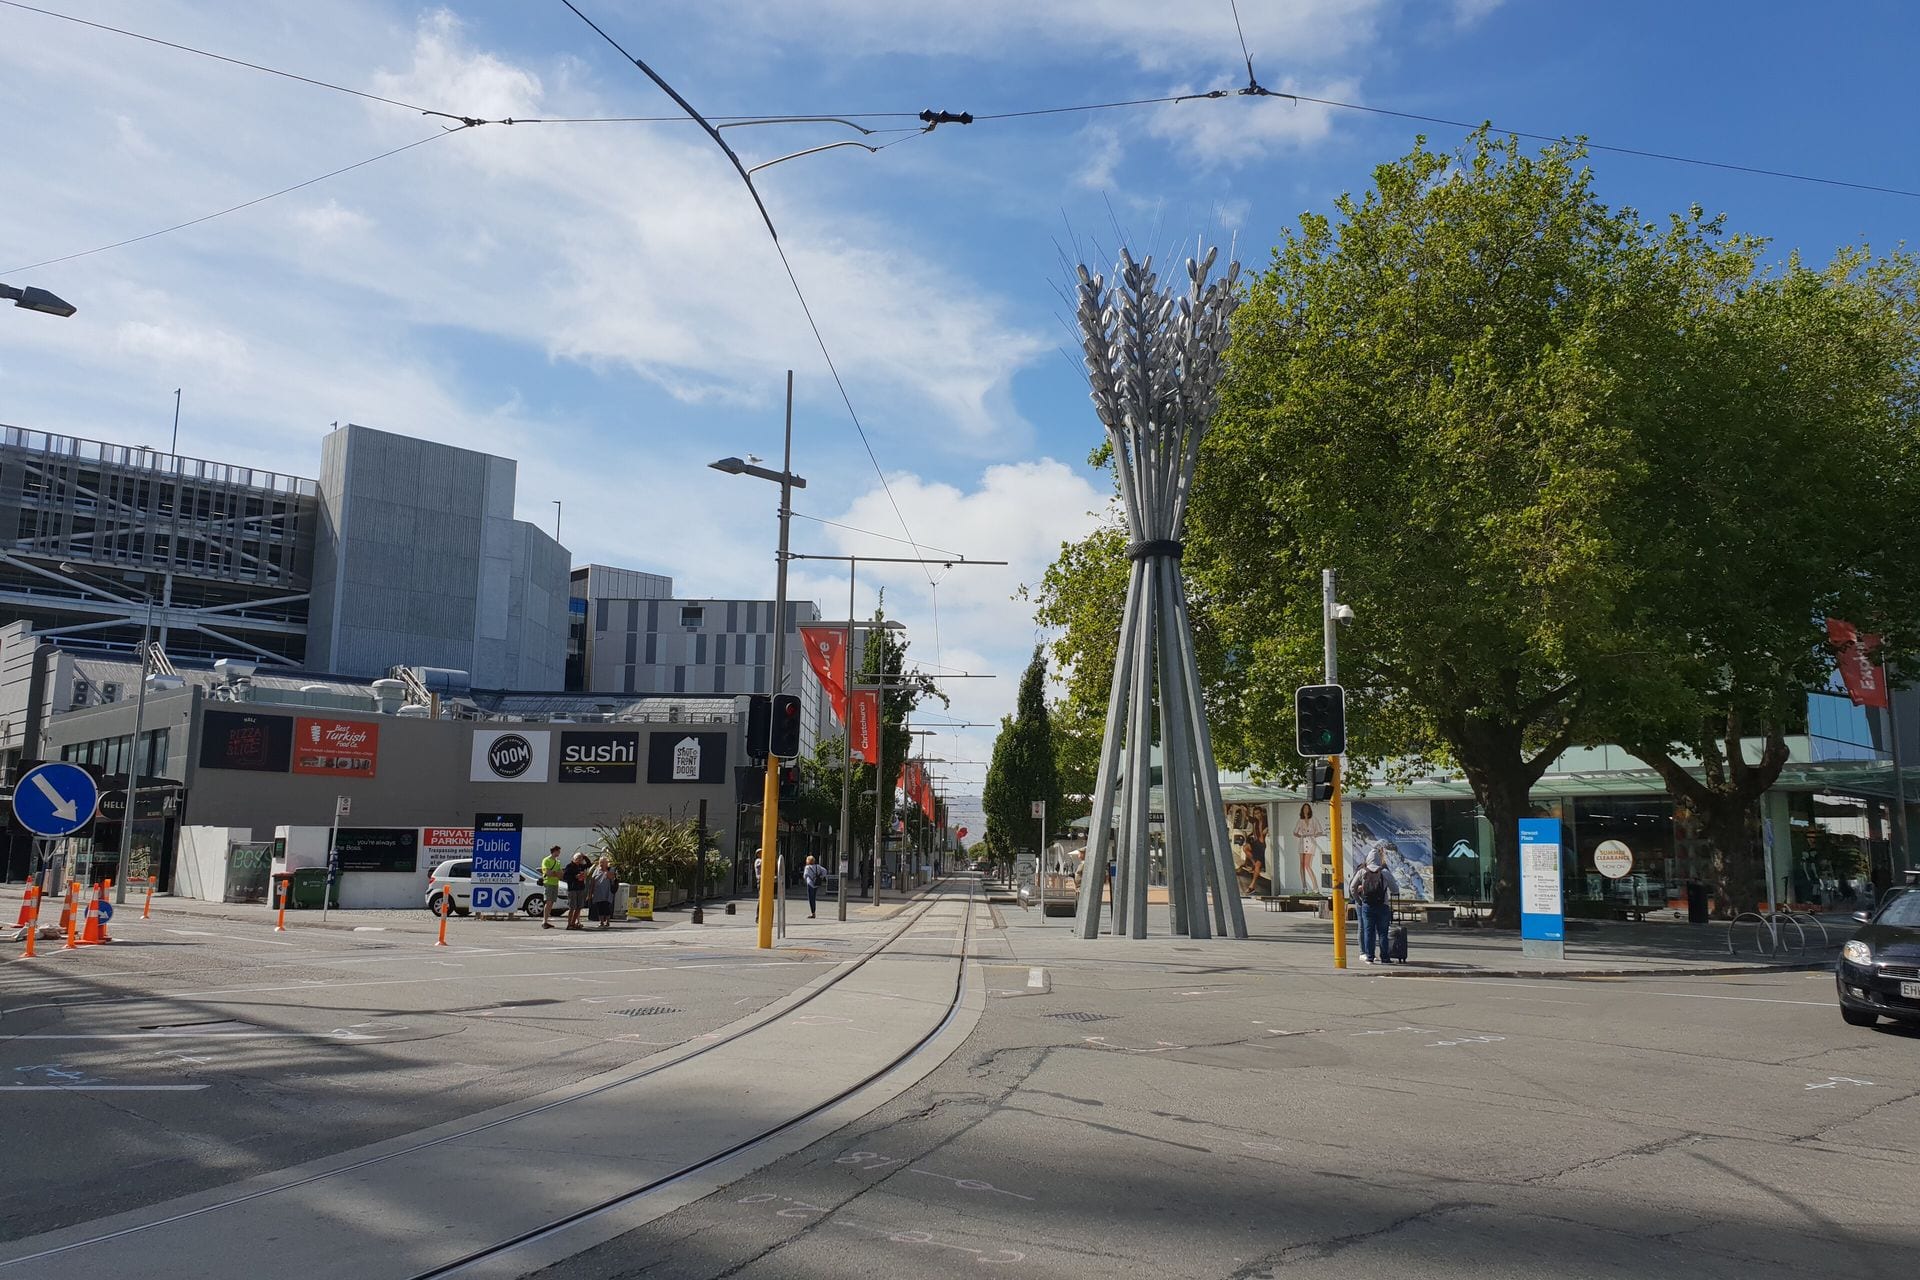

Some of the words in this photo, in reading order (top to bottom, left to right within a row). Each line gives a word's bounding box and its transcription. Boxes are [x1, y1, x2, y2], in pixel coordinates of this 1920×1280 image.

[335, 724, 351, 732] Best
[860, 702, 869, 749] Christchurch
[326, 730, 367, 742] Turkish
[491, 745, 529, 767] VOOM
[565, 741, 634, 761] sushi
[103, 801, 125, 809] HELL
[476, 838, 510, 852] Public
[233, 849, 272, 868] BOSS
[475, 857, 516, 872] Parking
[1903, 984, 1920, 996] EH
